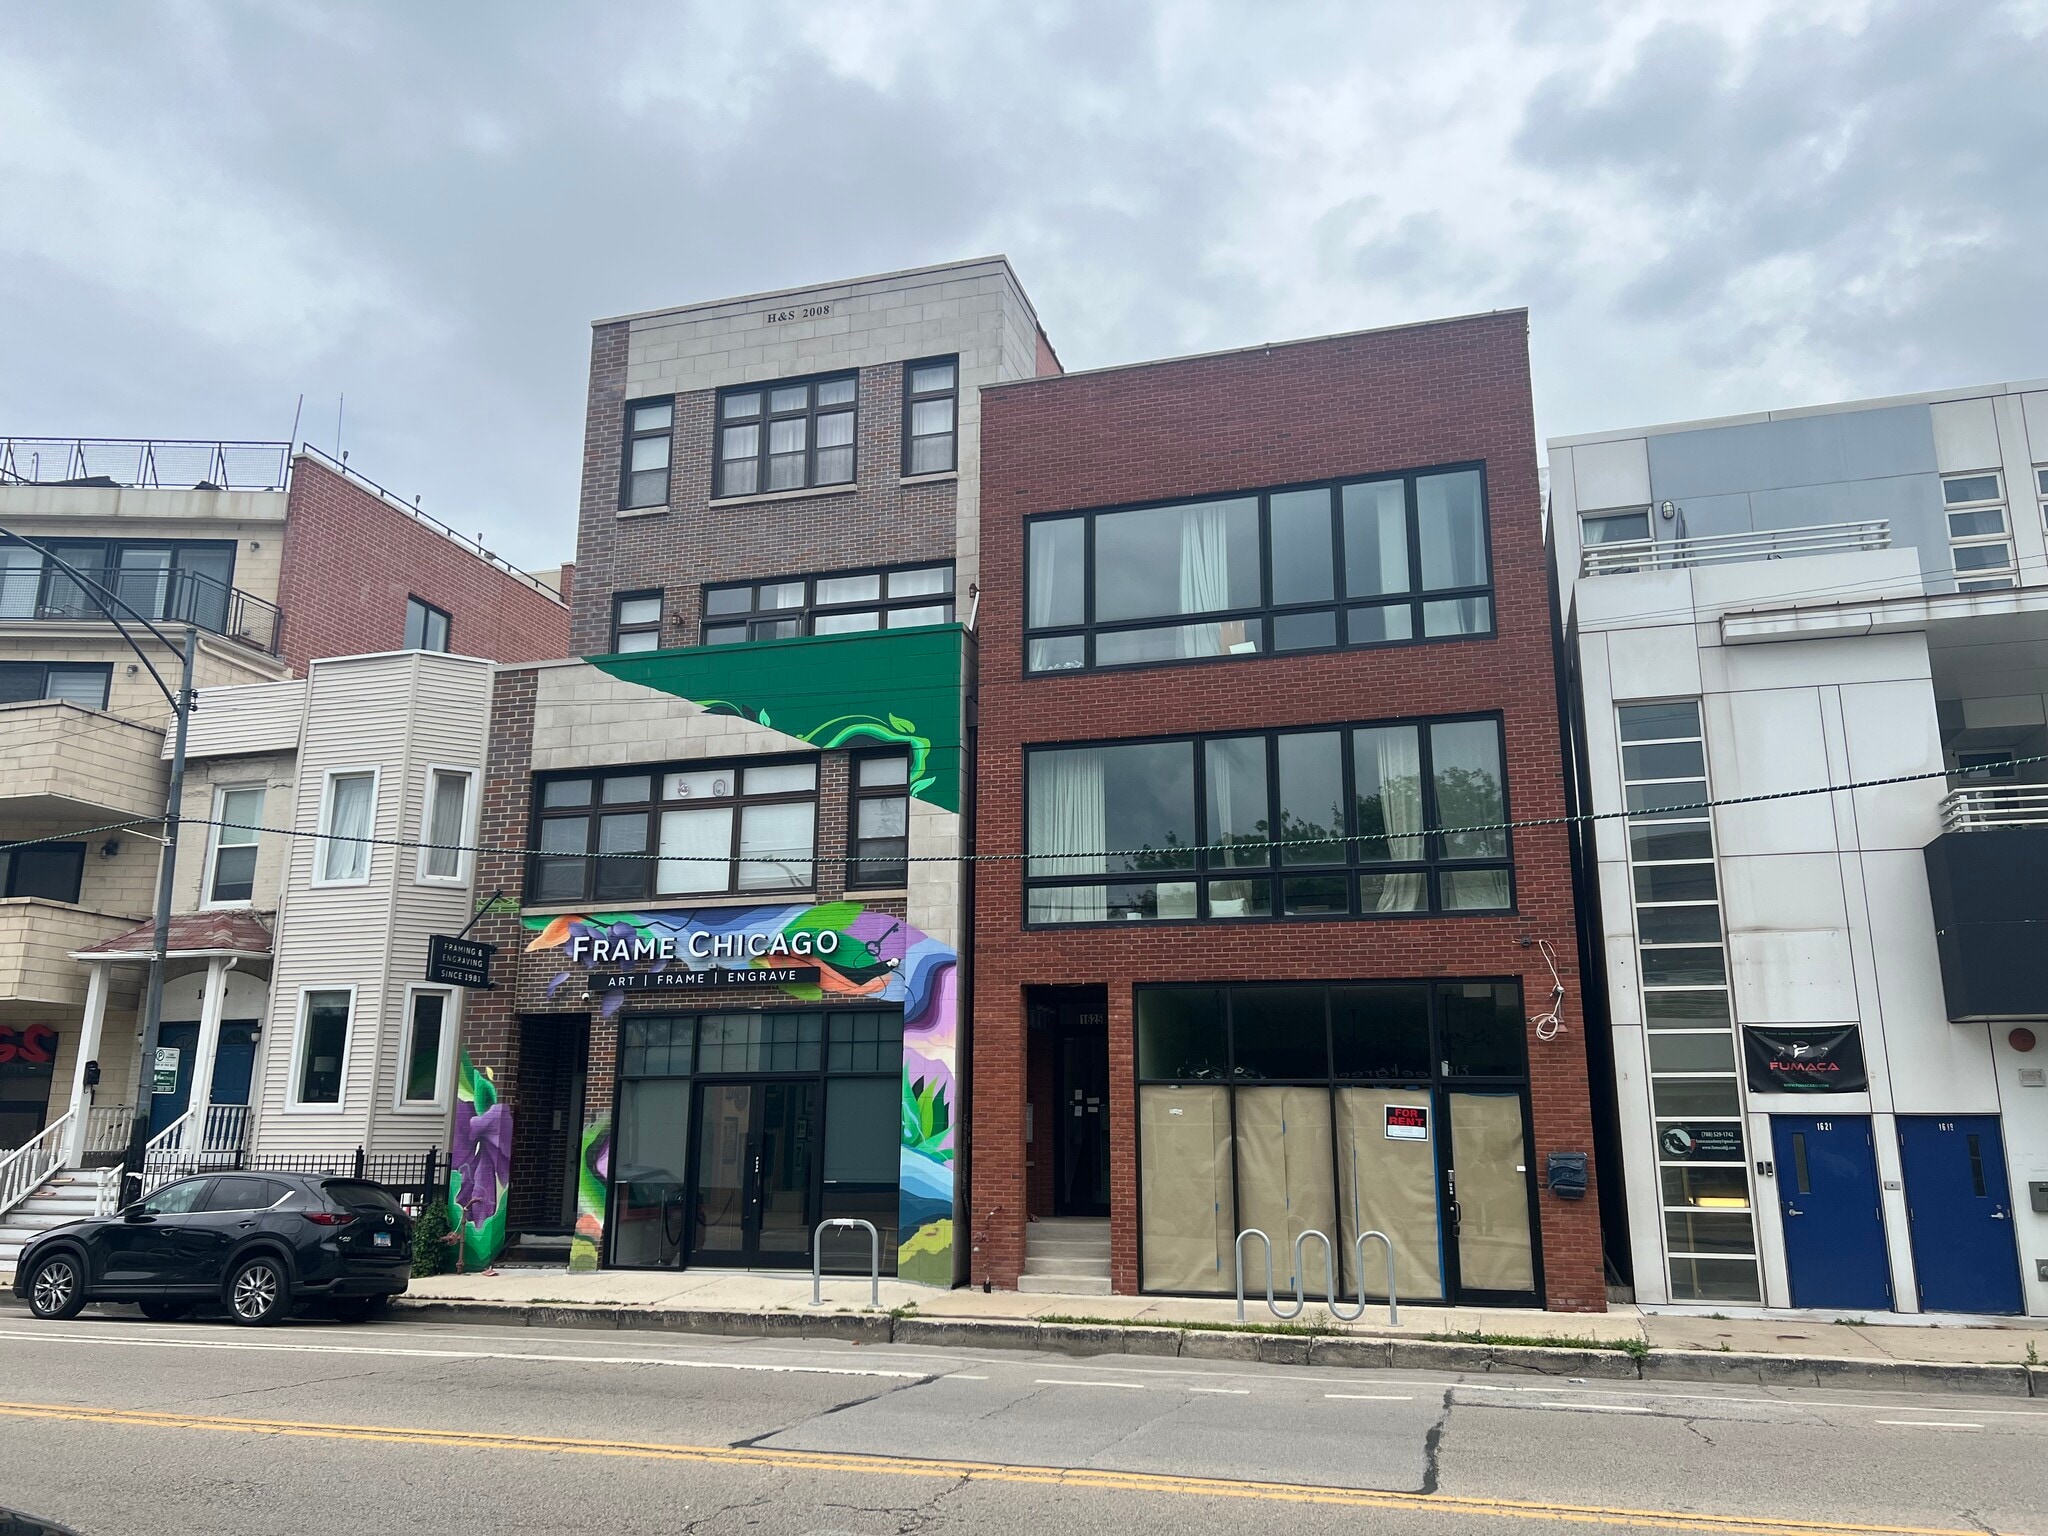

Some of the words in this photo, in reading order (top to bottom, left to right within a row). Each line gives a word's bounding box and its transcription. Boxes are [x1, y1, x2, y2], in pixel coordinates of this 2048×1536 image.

[767, 310, 795, 323] H&S
[802, 305, 830, 318] 2008
[444, 942, 476, 956] FRAMING
[478, 949, 483, 957] &
[572, 936, 677, 962] FRAME
[688, 930, 839, 958] CHICAGO
[442, 954, 483, 968] ENGRAVING
[441, 969, 463, 980] SINCE
[464, 973, 481, 983] 1981
[608, 976, 635, 987] ART
[657, 973, 705, 985] FRAME
[727, 970, 797, 983] ENGRAVE
[1080, 1014, 1103, 1025] 1625
[1395, 1108, 1418, 1118] FOR
[1388, 1116, 1425, 1127] RENT
[1816, 1122, 1832, 1131] 1621
